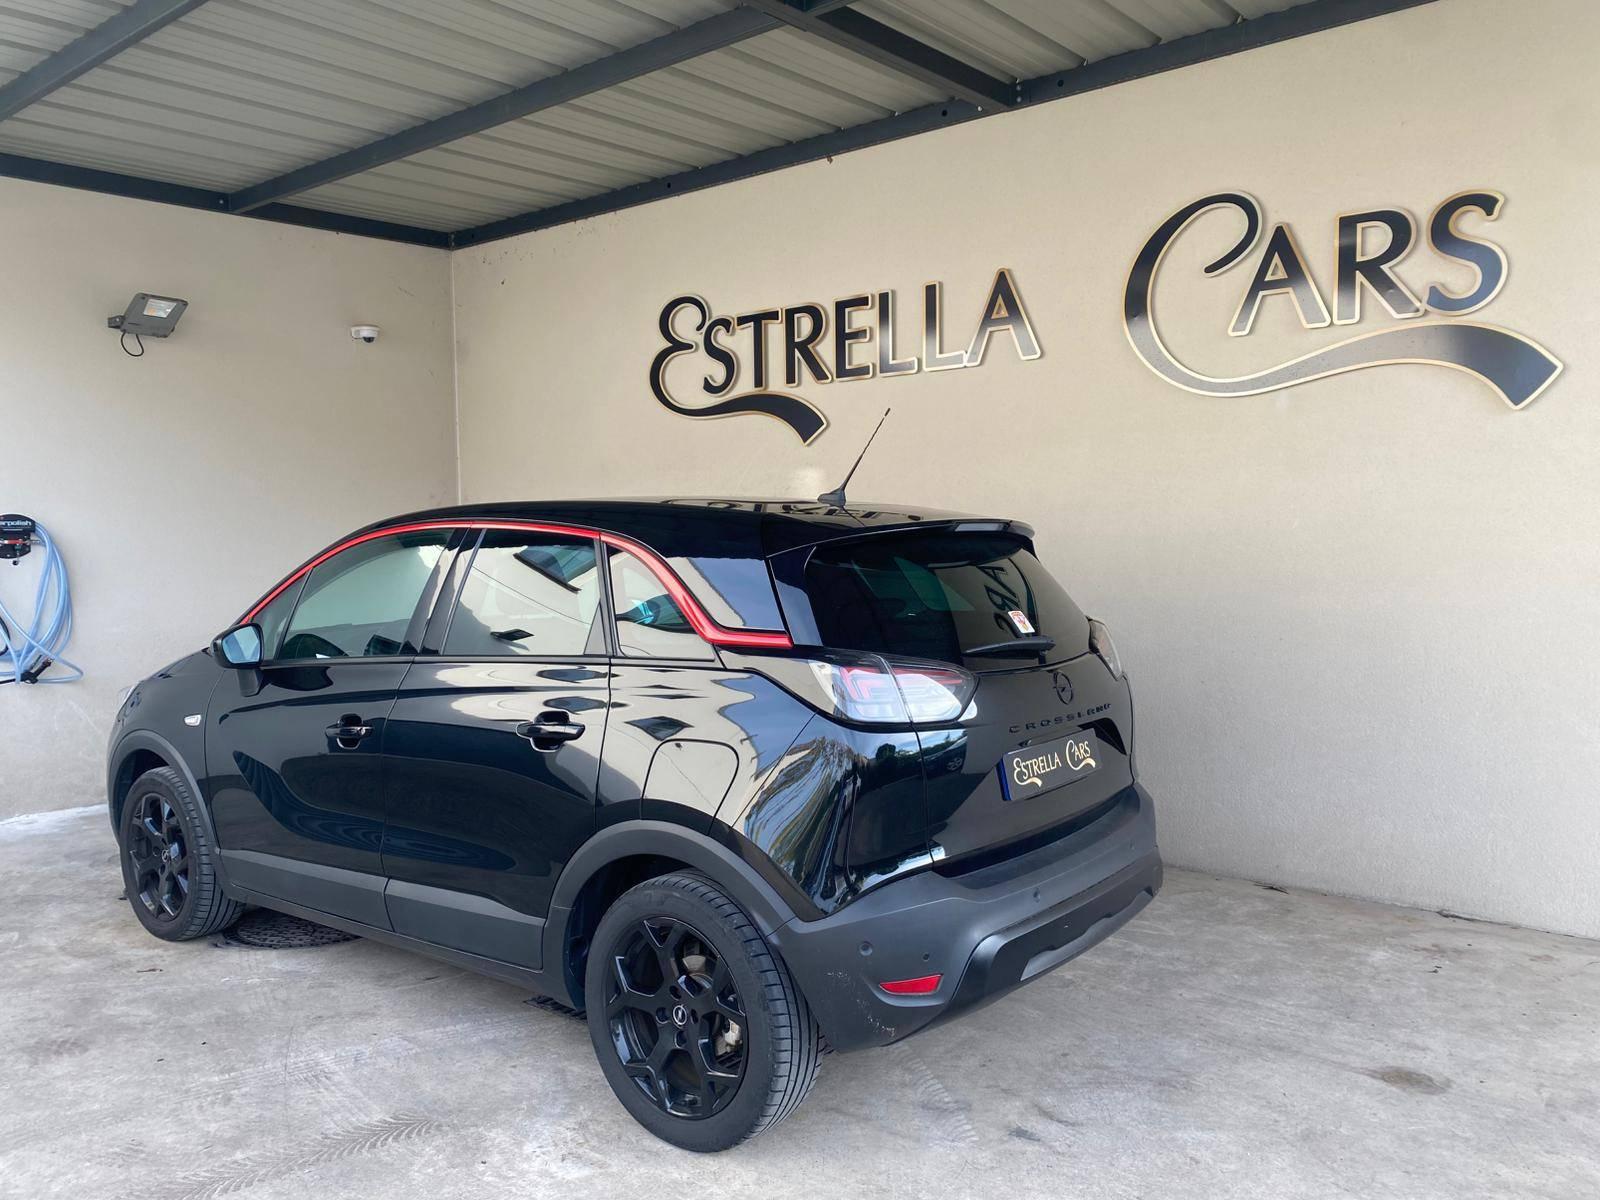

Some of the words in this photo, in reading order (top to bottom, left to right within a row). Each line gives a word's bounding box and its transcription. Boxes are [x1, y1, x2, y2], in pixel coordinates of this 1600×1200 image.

[650, 267, 1043, 447] ESTRELLA
[1122, 190, 1565, 411] CARS
[1013, 752, 1062, 788] ESTRELLA
[1066, 740, 1096, 770] CARS
